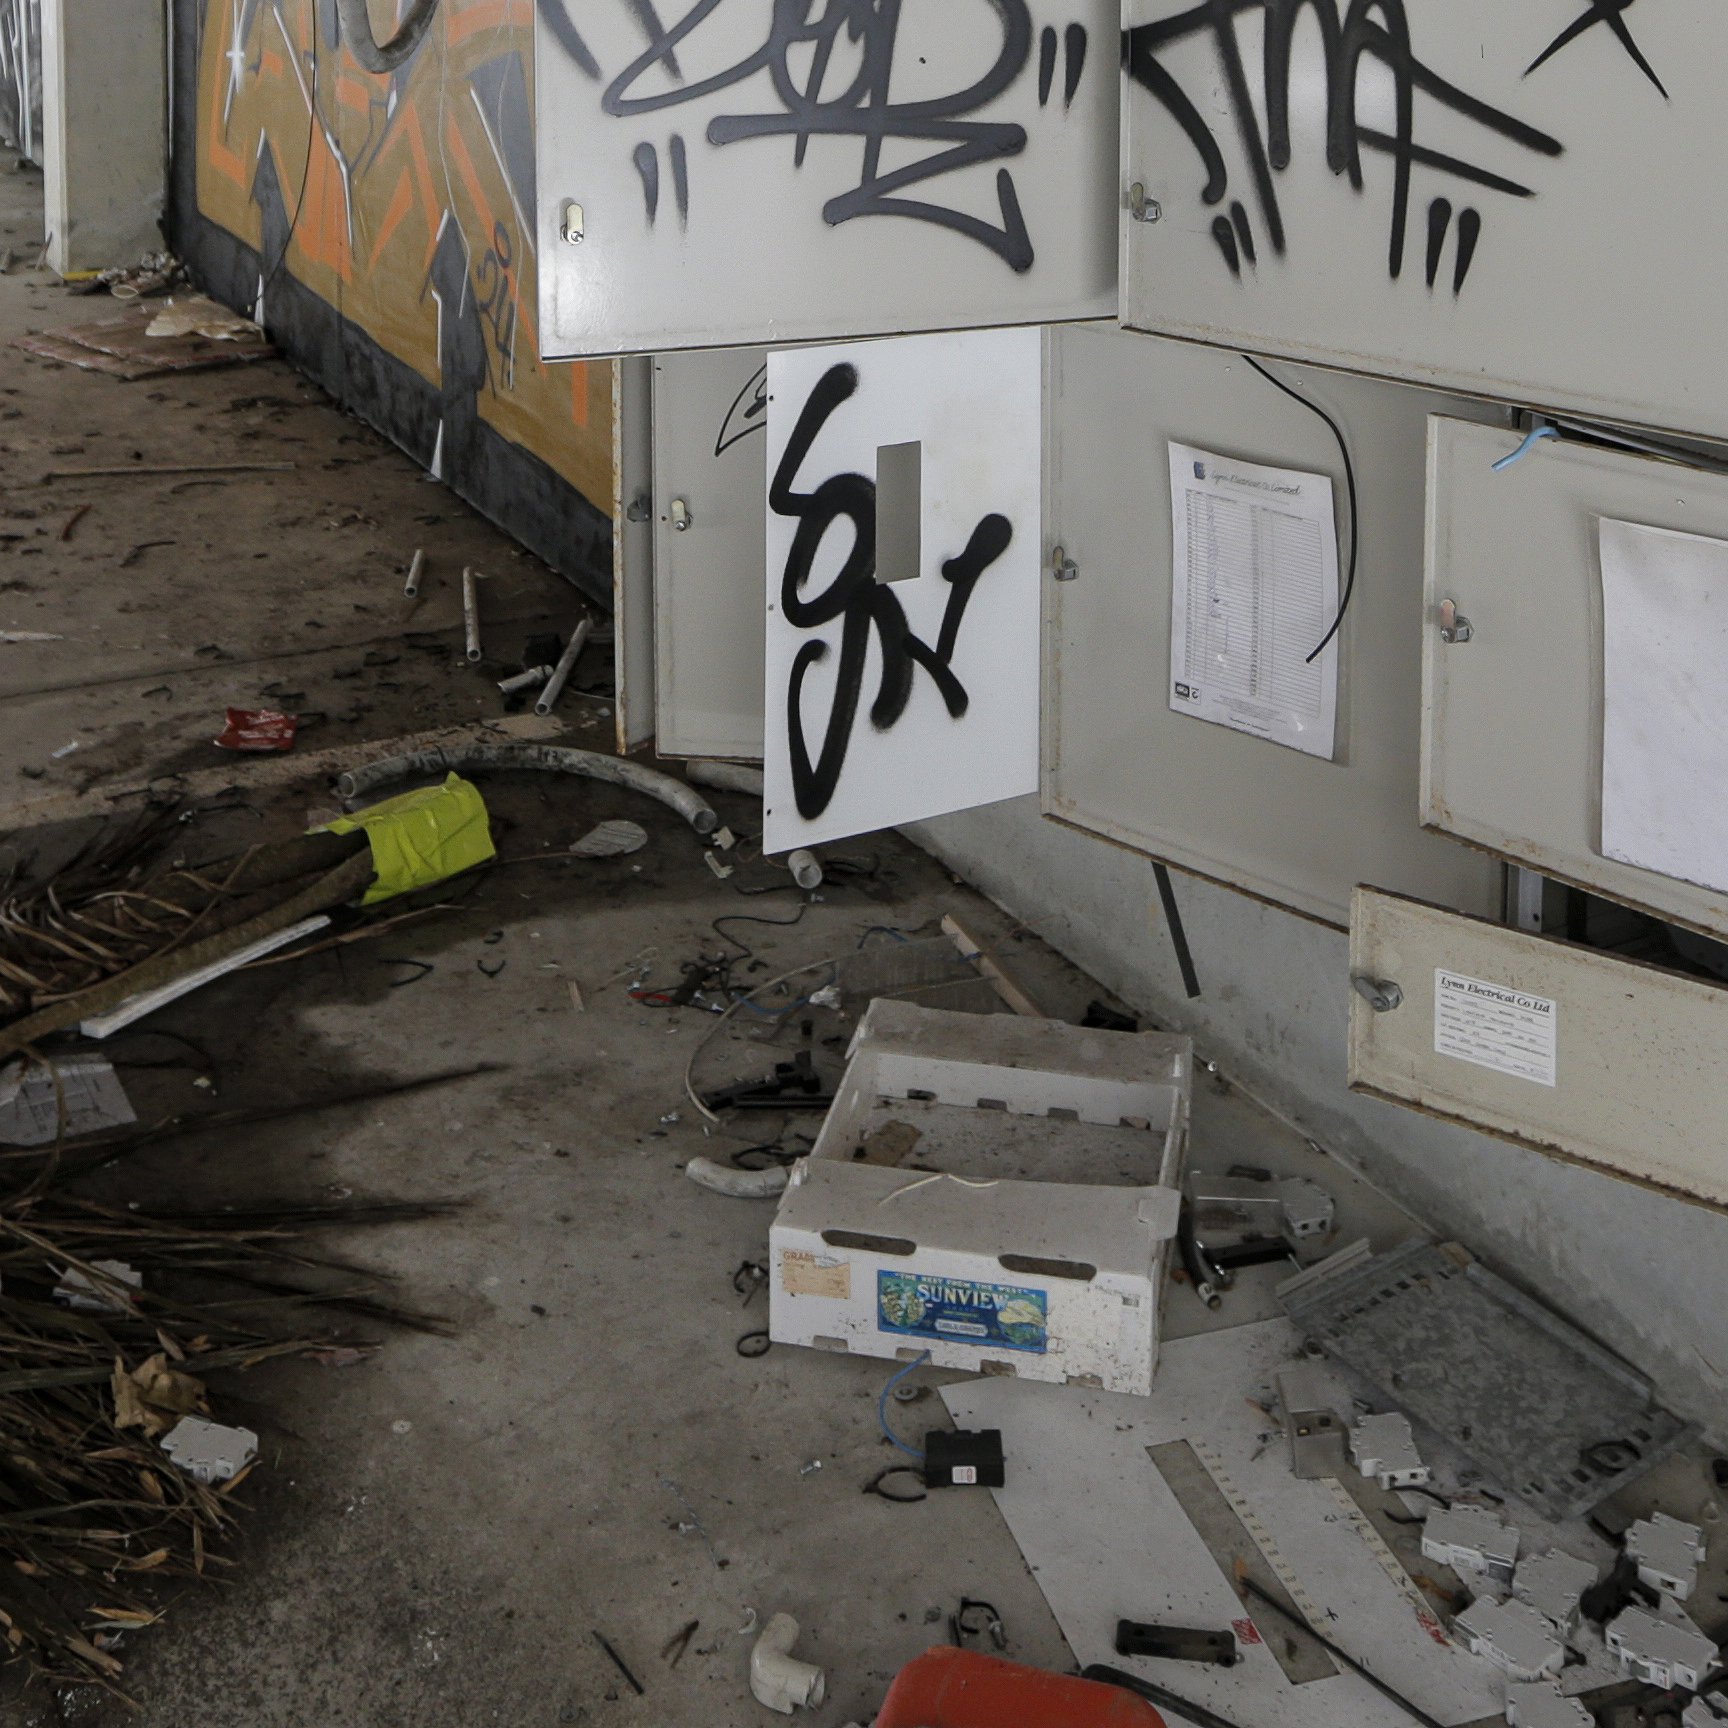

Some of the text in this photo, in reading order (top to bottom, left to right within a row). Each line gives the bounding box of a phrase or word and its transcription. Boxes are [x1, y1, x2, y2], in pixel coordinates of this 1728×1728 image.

[1440, 976, 1551, 1014] Lynn Electrical Co Ltd
[916, 1283, 1010, 1313] SUNVIEW
